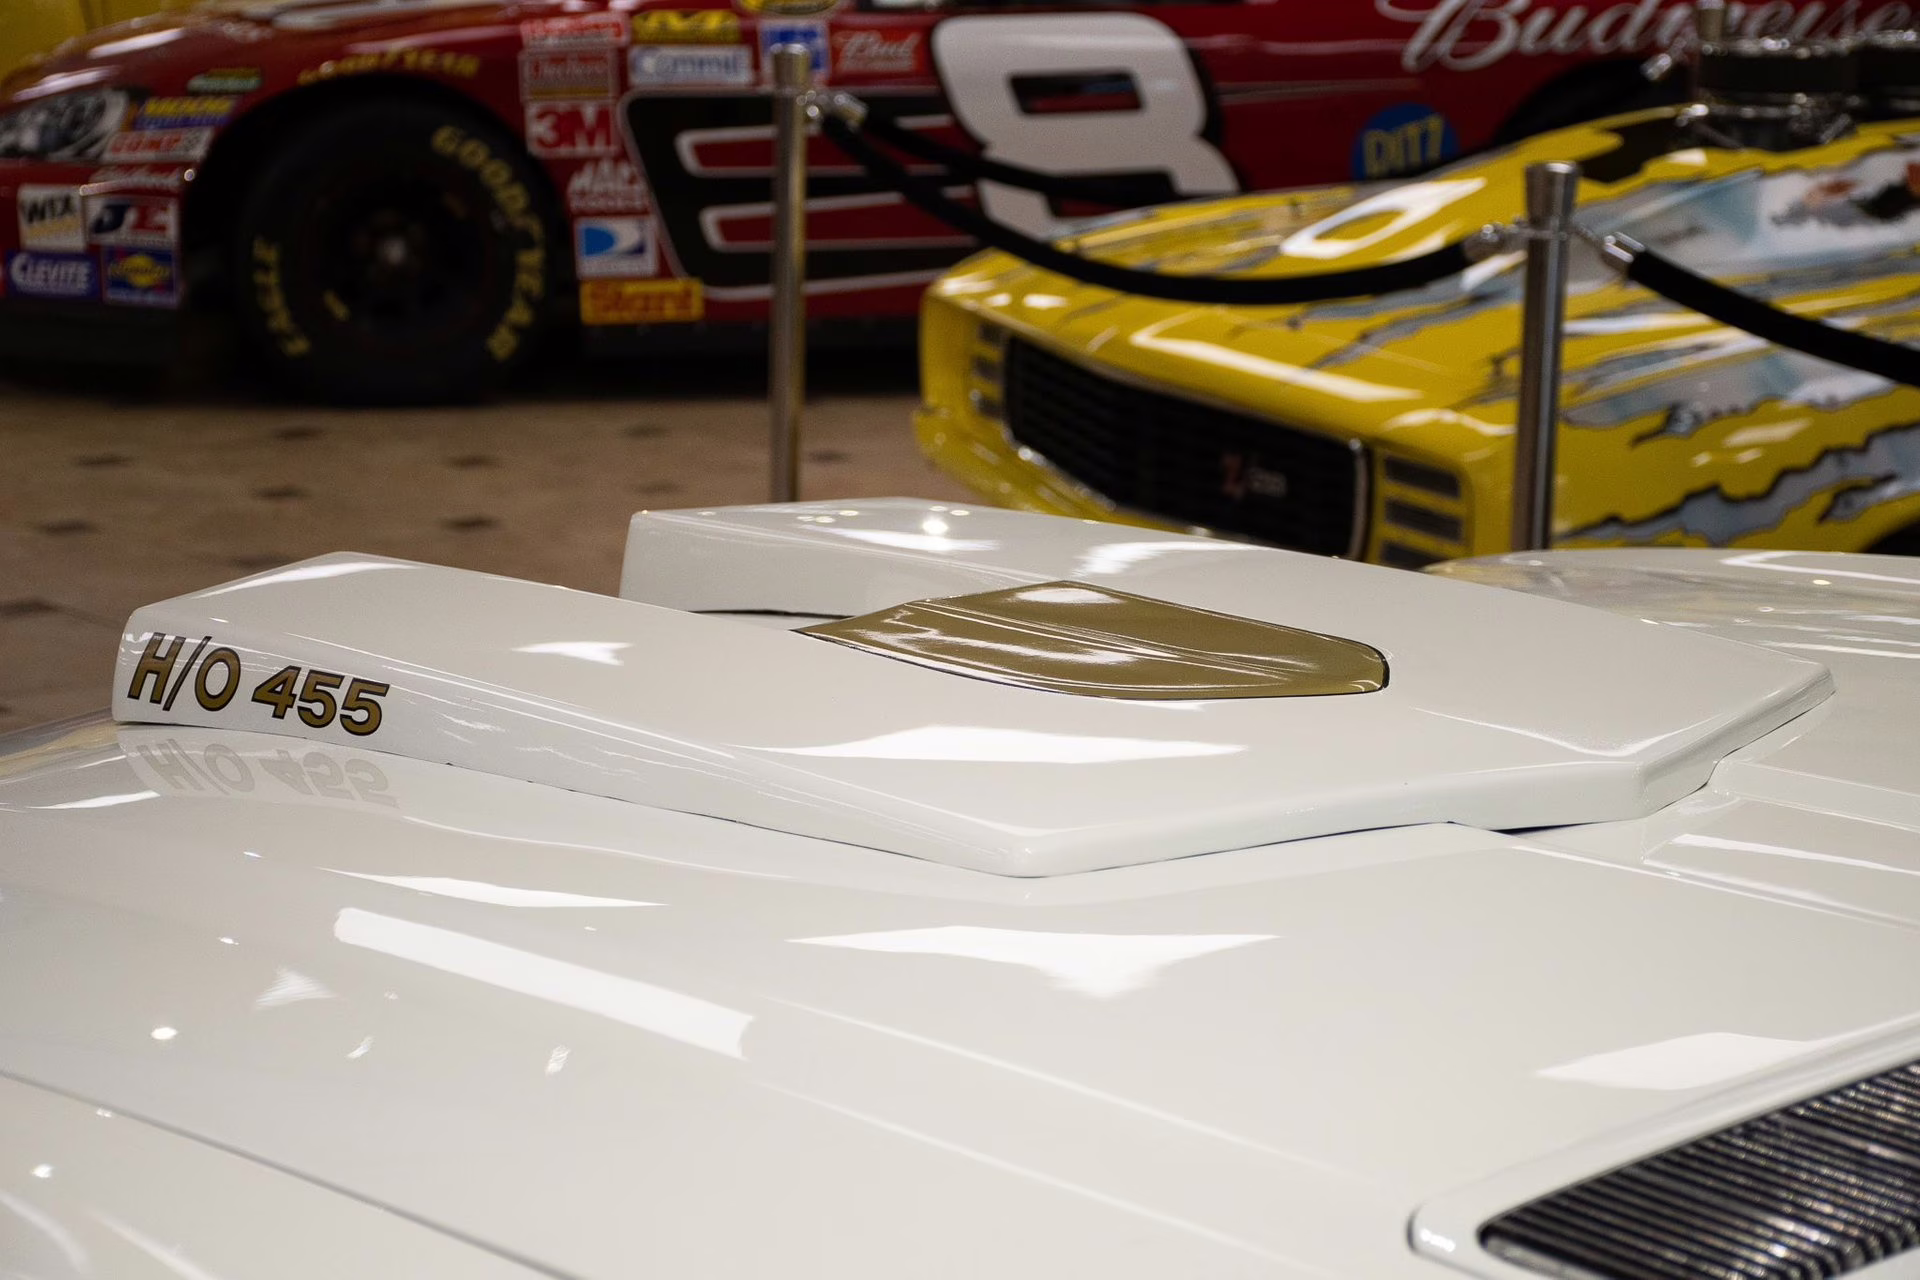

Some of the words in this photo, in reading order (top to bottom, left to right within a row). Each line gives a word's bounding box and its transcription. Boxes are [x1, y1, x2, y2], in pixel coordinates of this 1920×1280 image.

[1376, 0, 1920, 72] Budweise
[536, 109, 611, 148] 3M
[930, 11, 1243, 245] 8
[22, 195, 74, 223] WIX
[127, 632, 242, 712] H/O
[251, 665, 390, 736] 455
